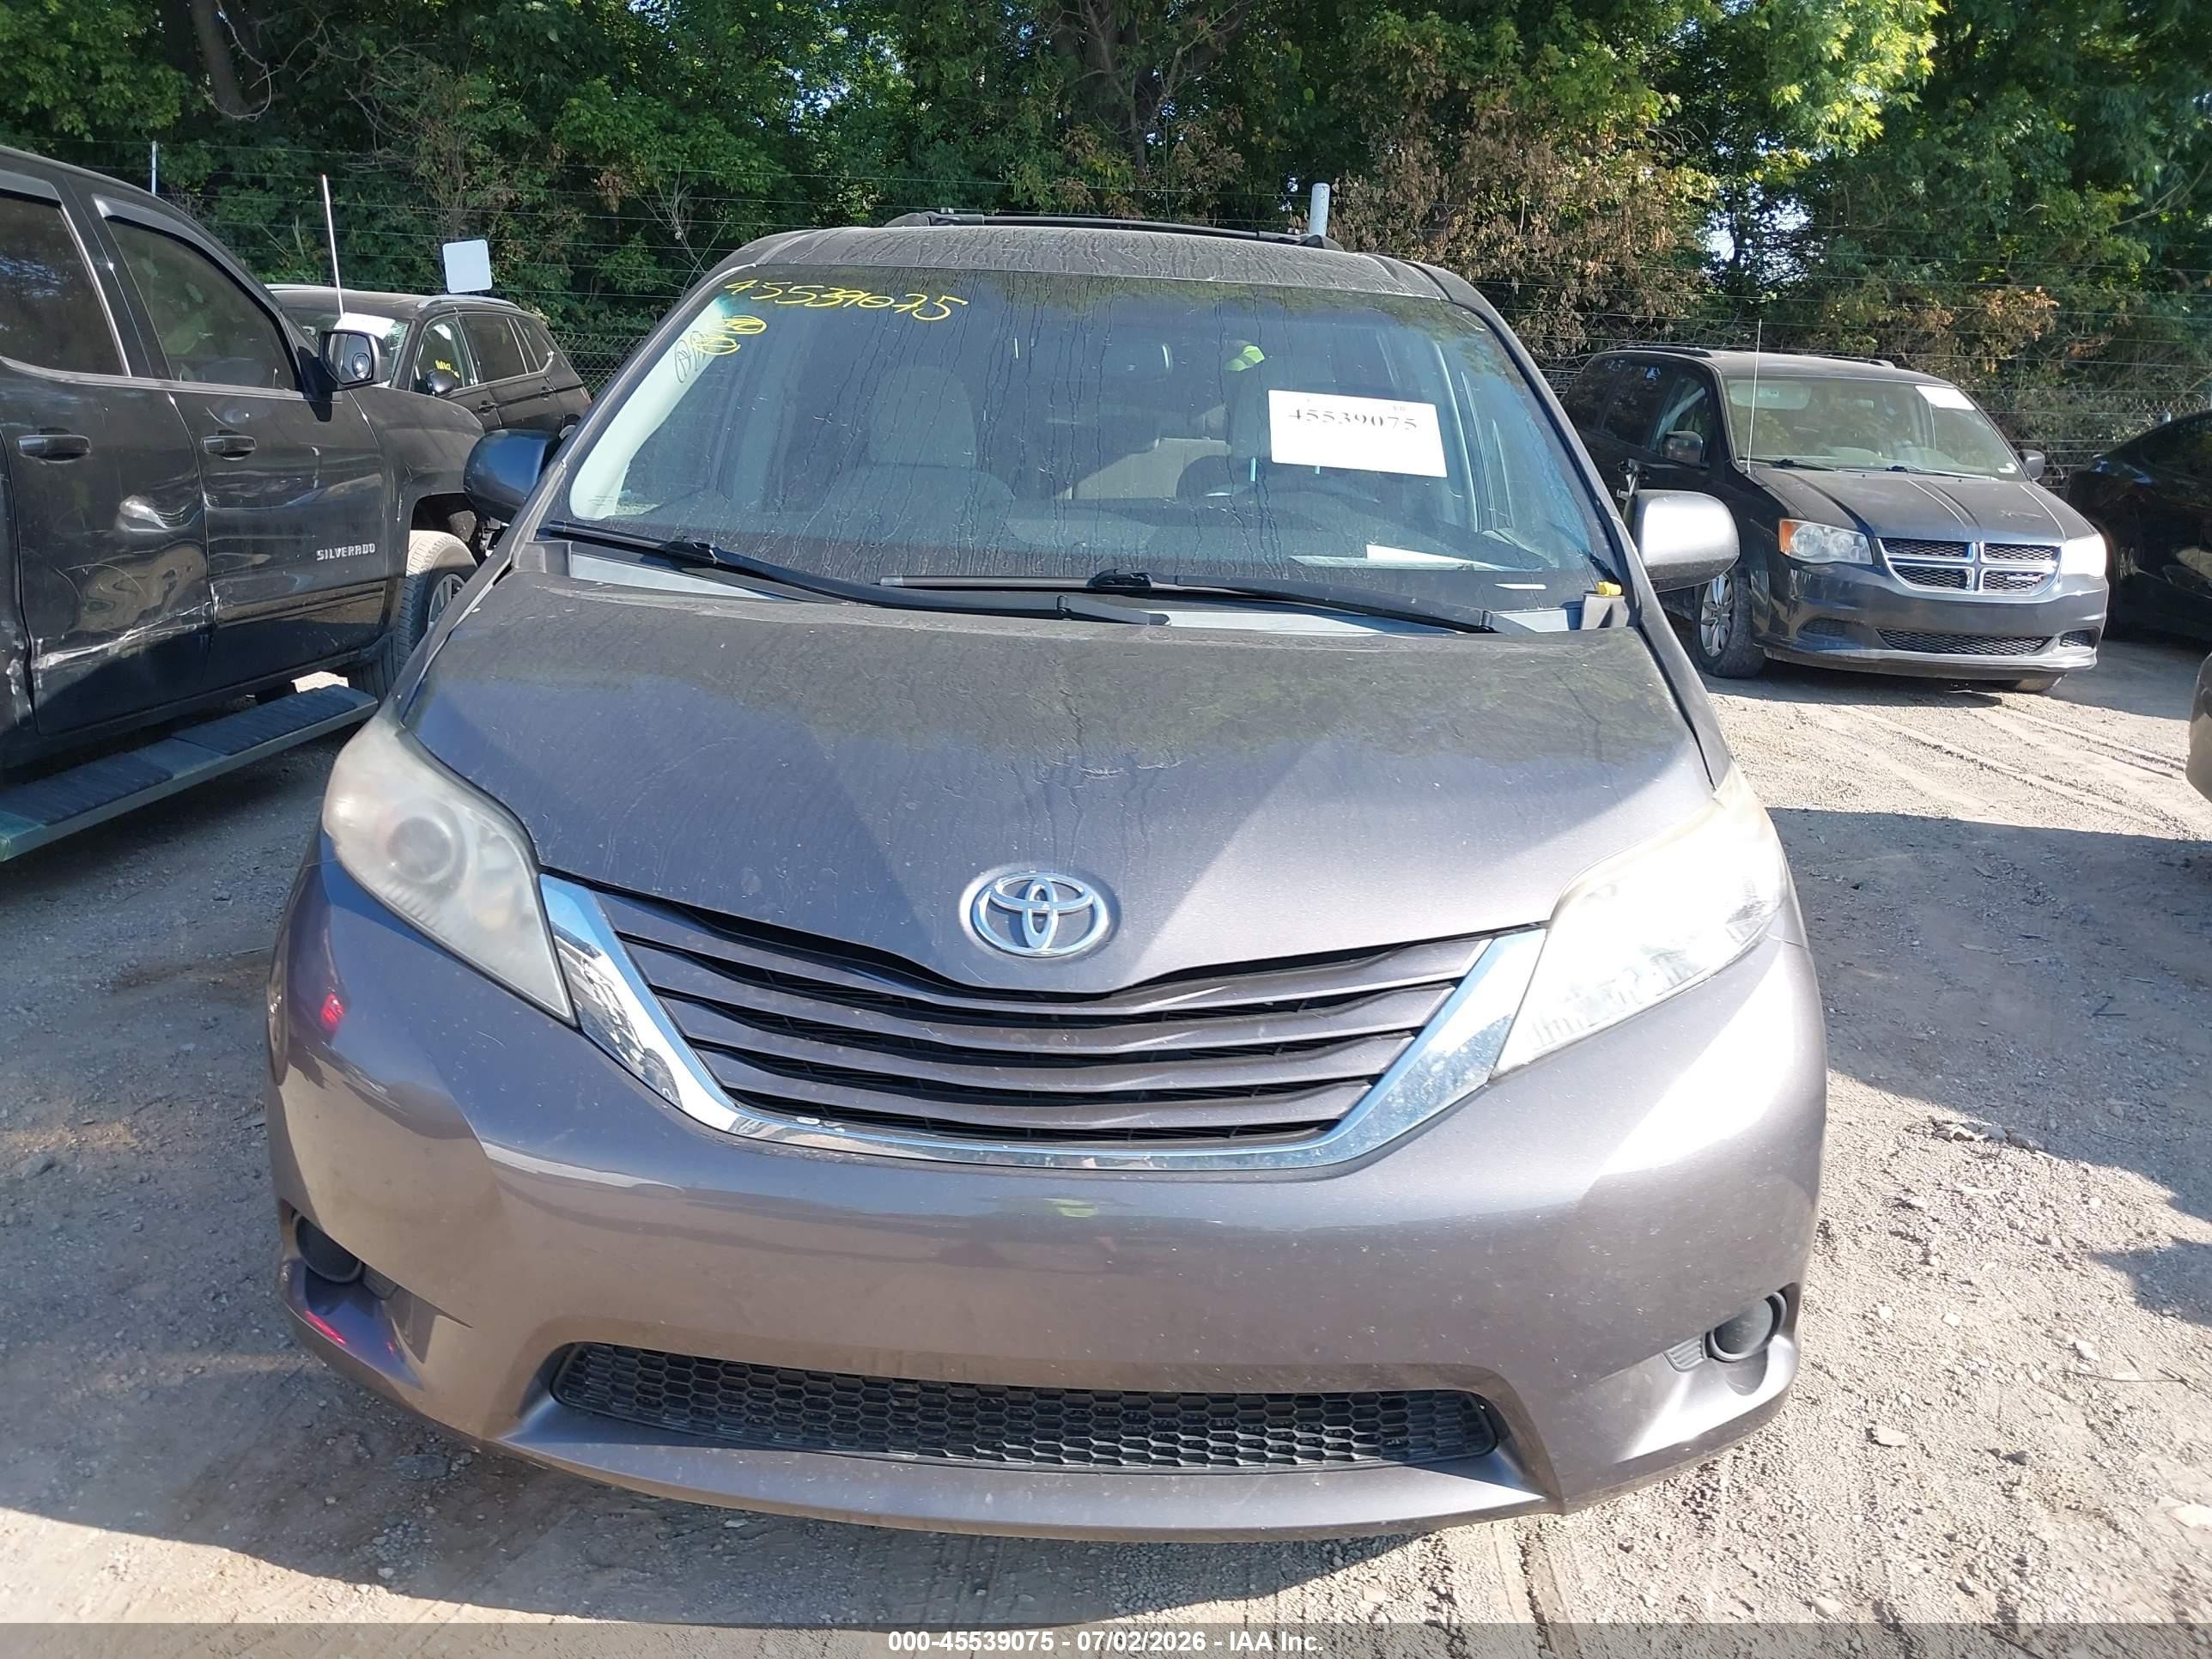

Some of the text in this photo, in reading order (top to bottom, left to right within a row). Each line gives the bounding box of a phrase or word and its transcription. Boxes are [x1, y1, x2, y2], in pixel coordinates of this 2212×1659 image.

[725, 279, 968, 320] 45539075
[1289, 409, 1417, 429] 45539075
[316, 543, 375, 561] SILVERADO
